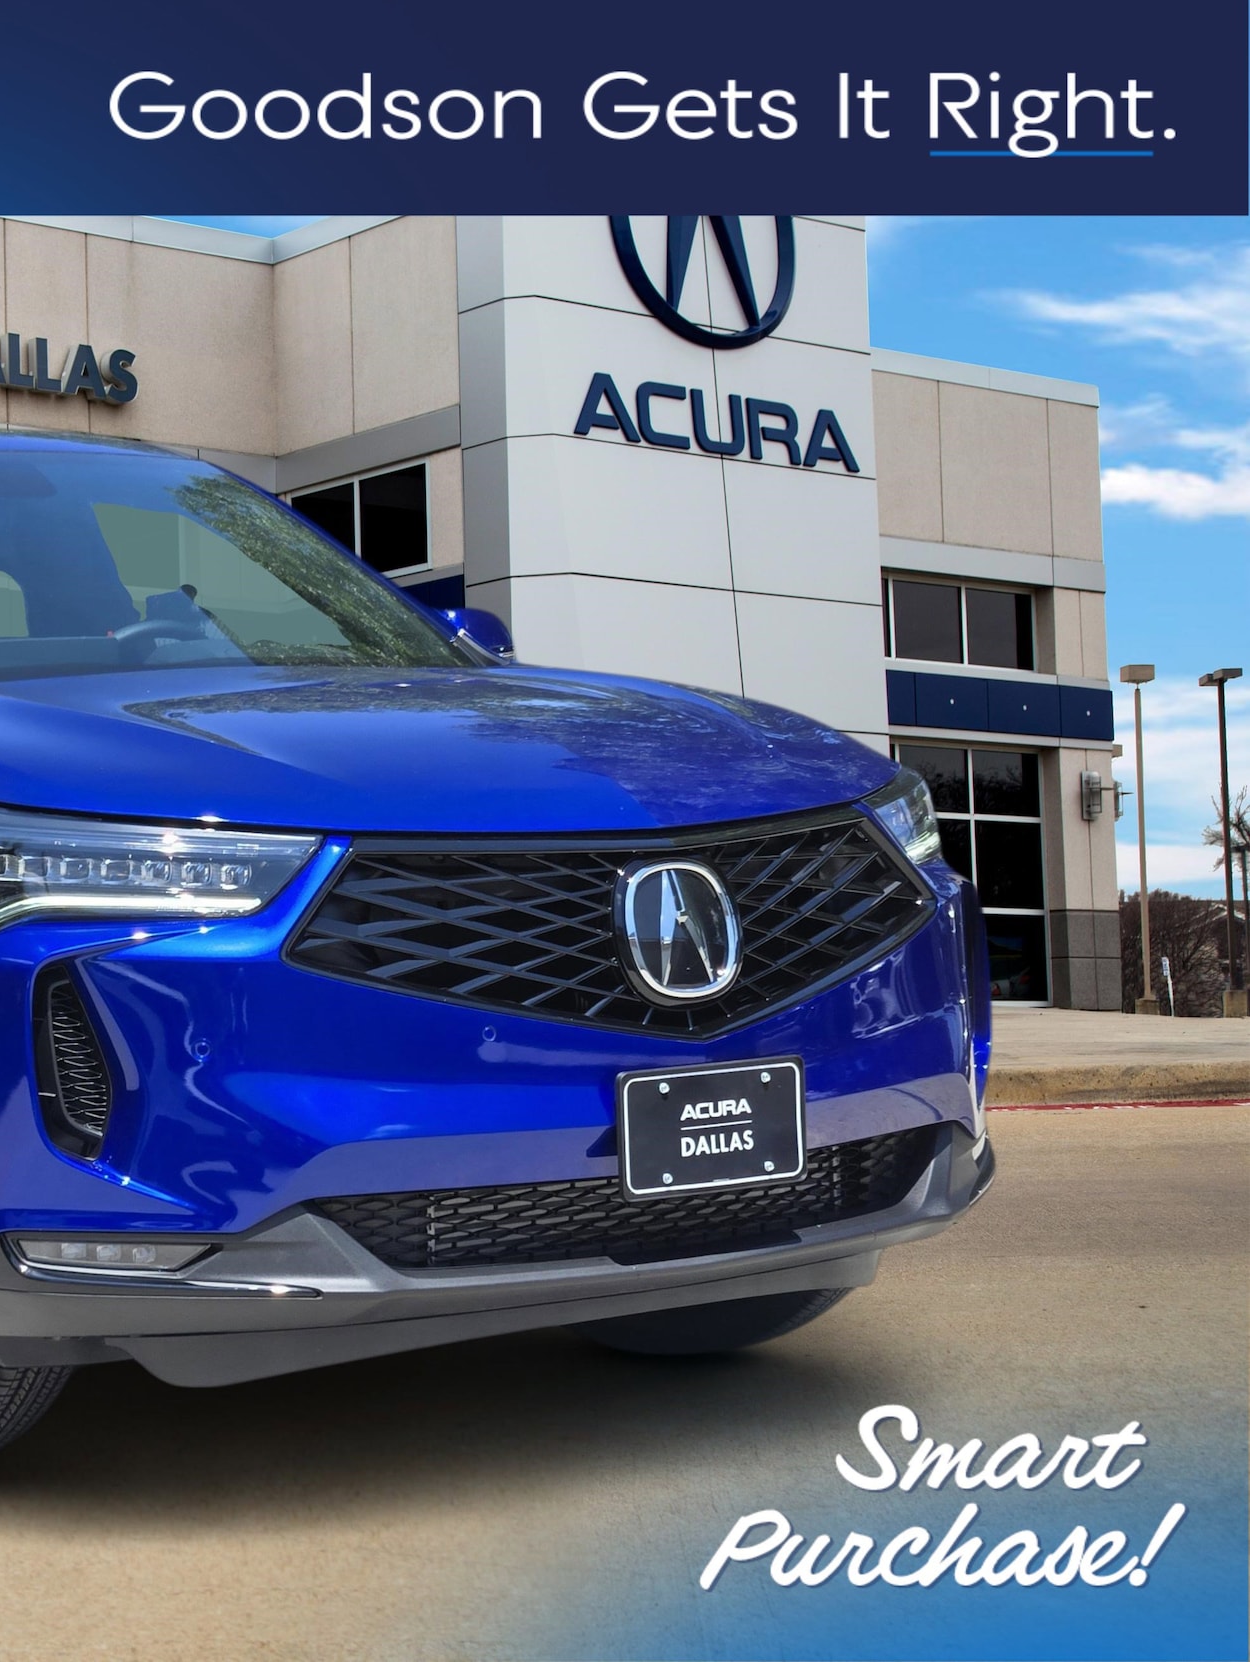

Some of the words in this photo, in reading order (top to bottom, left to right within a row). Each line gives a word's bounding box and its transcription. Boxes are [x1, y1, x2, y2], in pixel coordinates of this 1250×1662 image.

[573, 371, 860, 474] ACURA
[680, 1097, 752, 1121] ACURA
[680, 1129, 754, 1158] DALLAS
